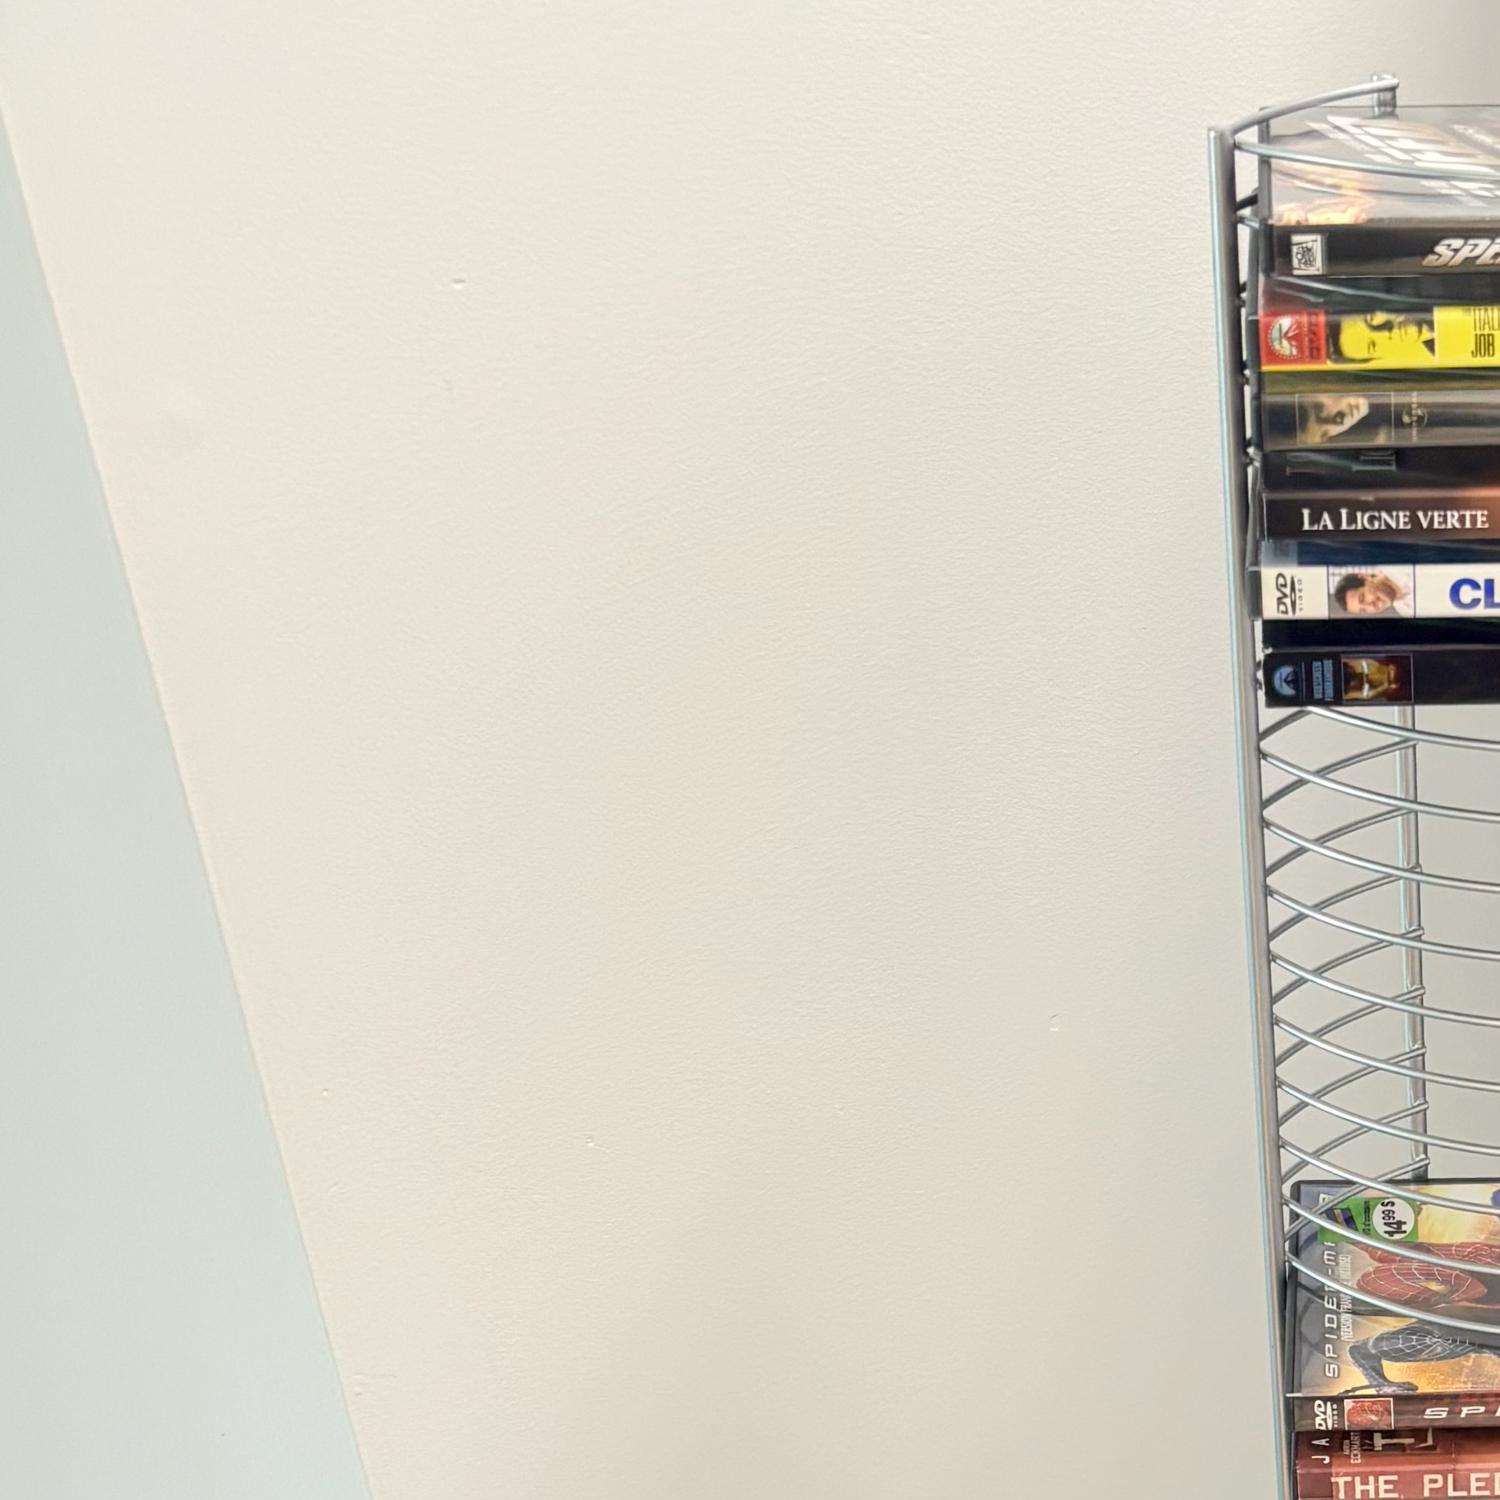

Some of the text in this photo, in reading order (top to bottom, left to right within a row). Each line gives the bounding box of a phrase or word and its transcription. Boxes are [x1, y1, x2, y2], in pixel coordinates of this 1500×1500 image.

[1471, 334, 1496, 358] JOB
[1302, 508, 1334, 530] LA
[1339, 506, 1412, 530] LIGNE
[1276, 572, 1289, 616] DVD
[1314, 1400, 1326, 1430] DVD
[1331, 1475, 1400, 1499] THE
